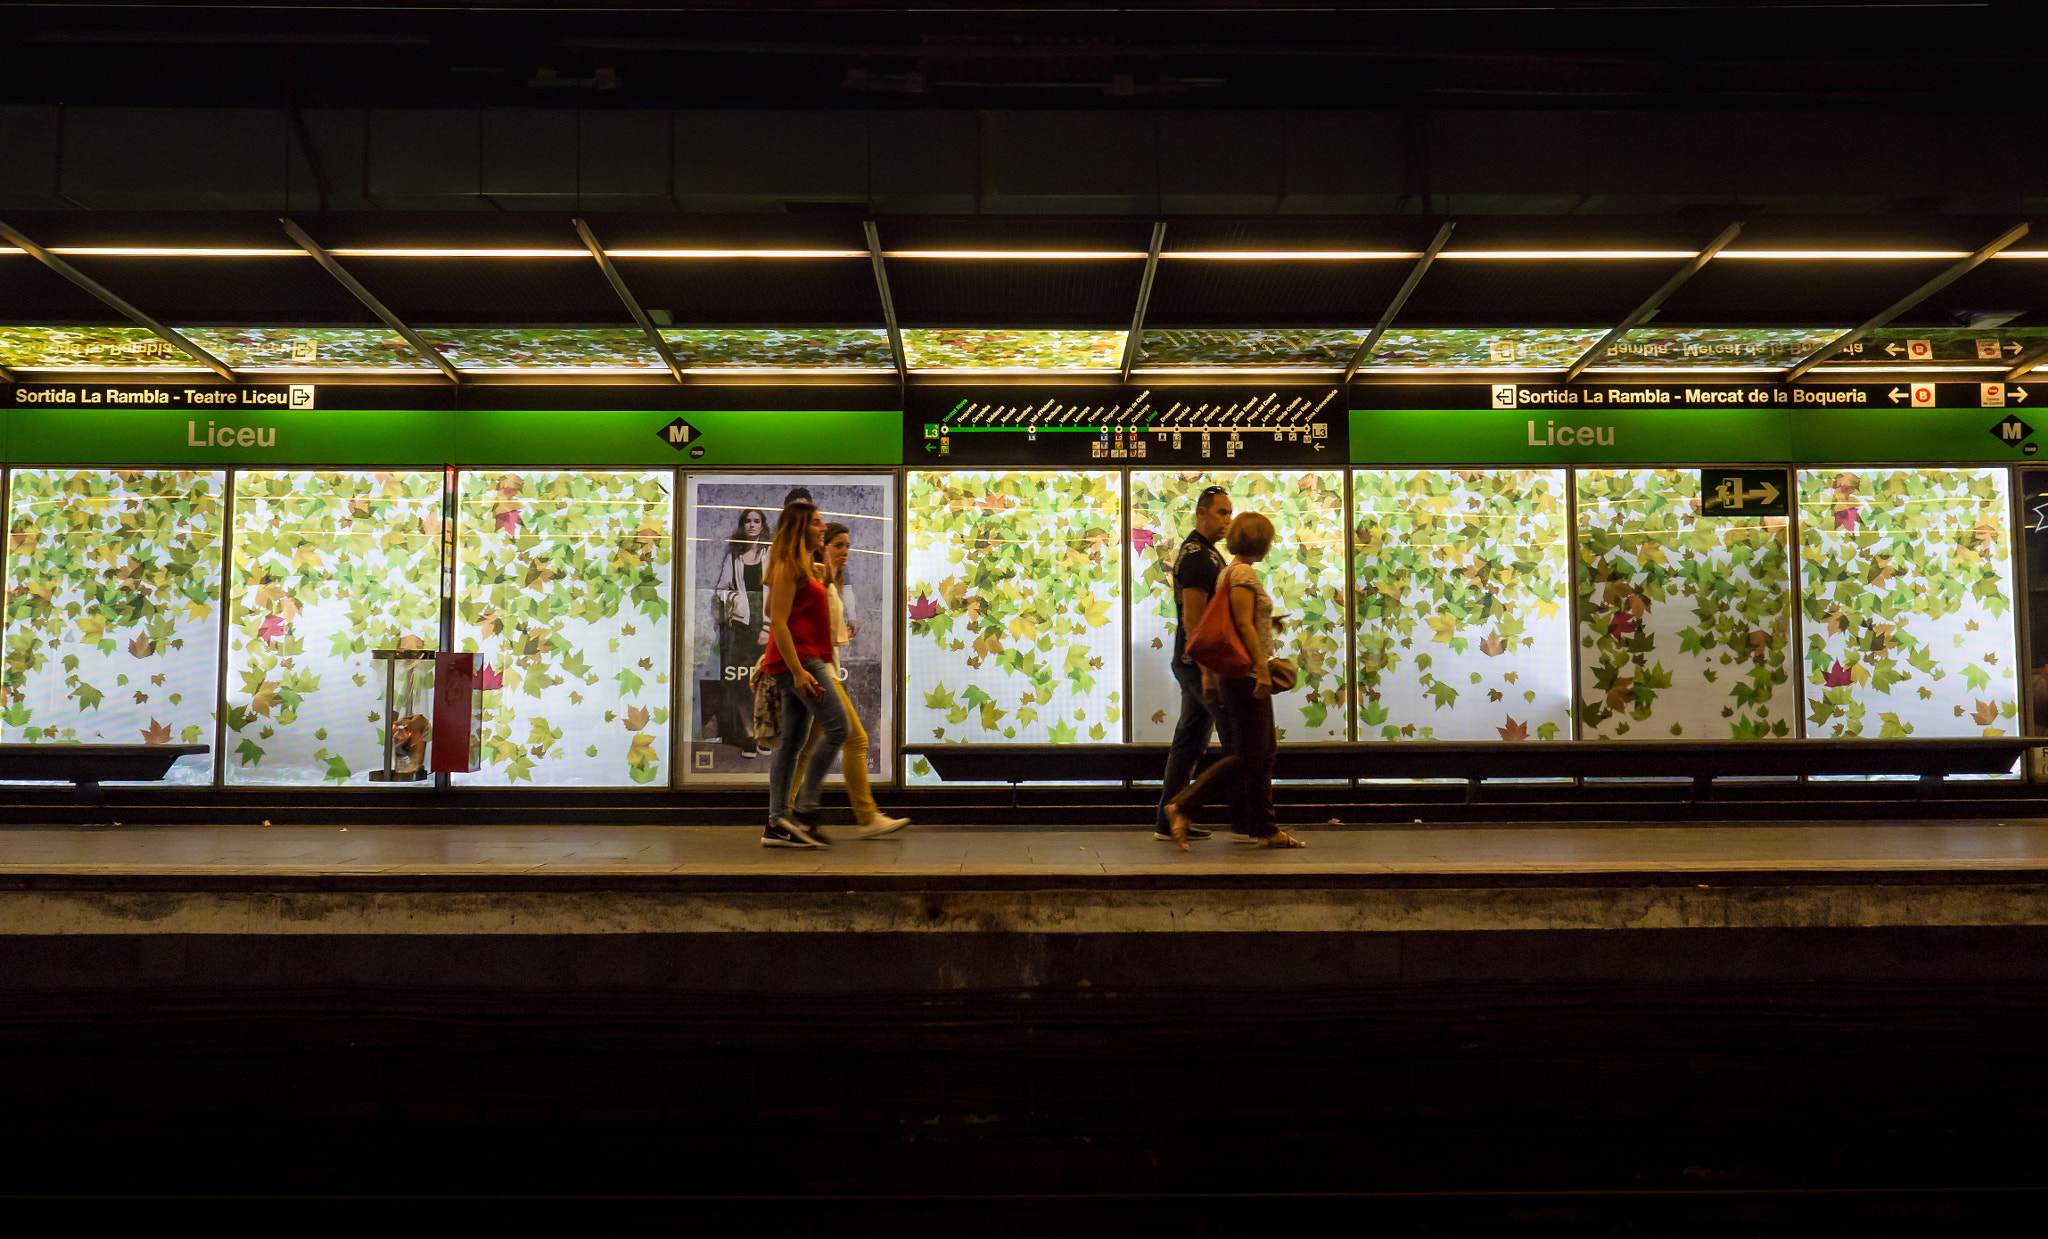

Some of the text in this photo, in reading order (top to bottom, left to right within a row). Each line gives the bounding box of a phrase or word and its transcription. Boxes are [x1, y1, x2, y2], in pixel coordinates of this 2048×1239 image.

[15, 389, 76, 404] Sortida
[81, 390, 101, 404] La
[106, 389, 169, 404] Rambla
[184, 389, 237, 404] Teatre
[242, 389, 287, 404] Liceu
[1518, 389, 1578, 404] Sortida
[1583, 390, 1603, 404] La
[1608, 389, 1670, 404] Rambla
[1685, 389, 1743, 404] Mercat
[1749, 389, 1769, 404] de
[1773, 389, 1788, 404] la
[1793, 389, 1867, 407] Boqueria
[1919, 392, 1928, 401] B
[188, 421, 275, 447] Liceu
[669, 425, 689, 443] M
[925, 429, 939, 438] L3
[1313, 428, 1326, 437] L3
[1527, 421, 1614, 447] Liceu
[2002, 422, 2022, 440] M
